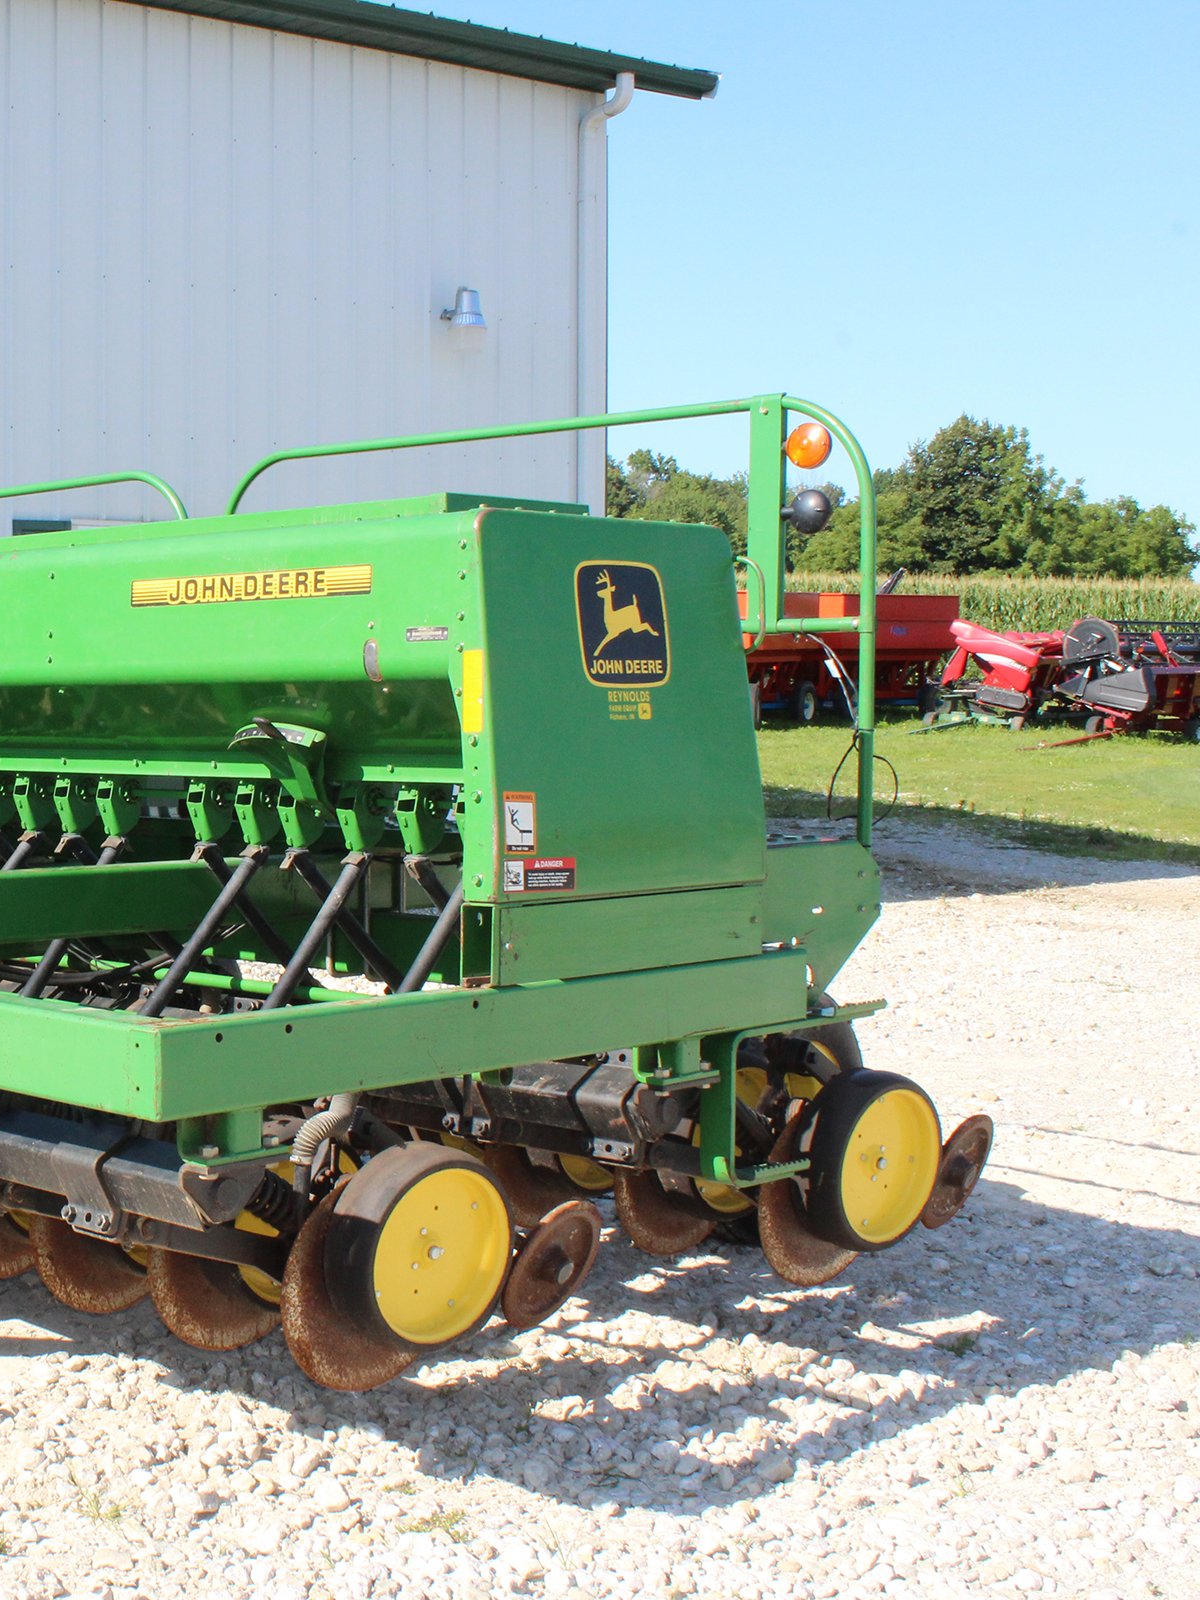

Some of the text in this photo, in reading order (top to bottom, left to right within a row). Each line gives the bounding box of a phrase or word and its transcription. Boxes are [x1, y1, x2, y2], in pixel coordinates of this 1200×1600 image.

[169, 570, 326, 602] JOHN DEERE
[590, 659, 663, 674] JOHN DEERE
[608, 691, 650, 702] REYNOLDS
[541, 860, 563, 868] DANGER
